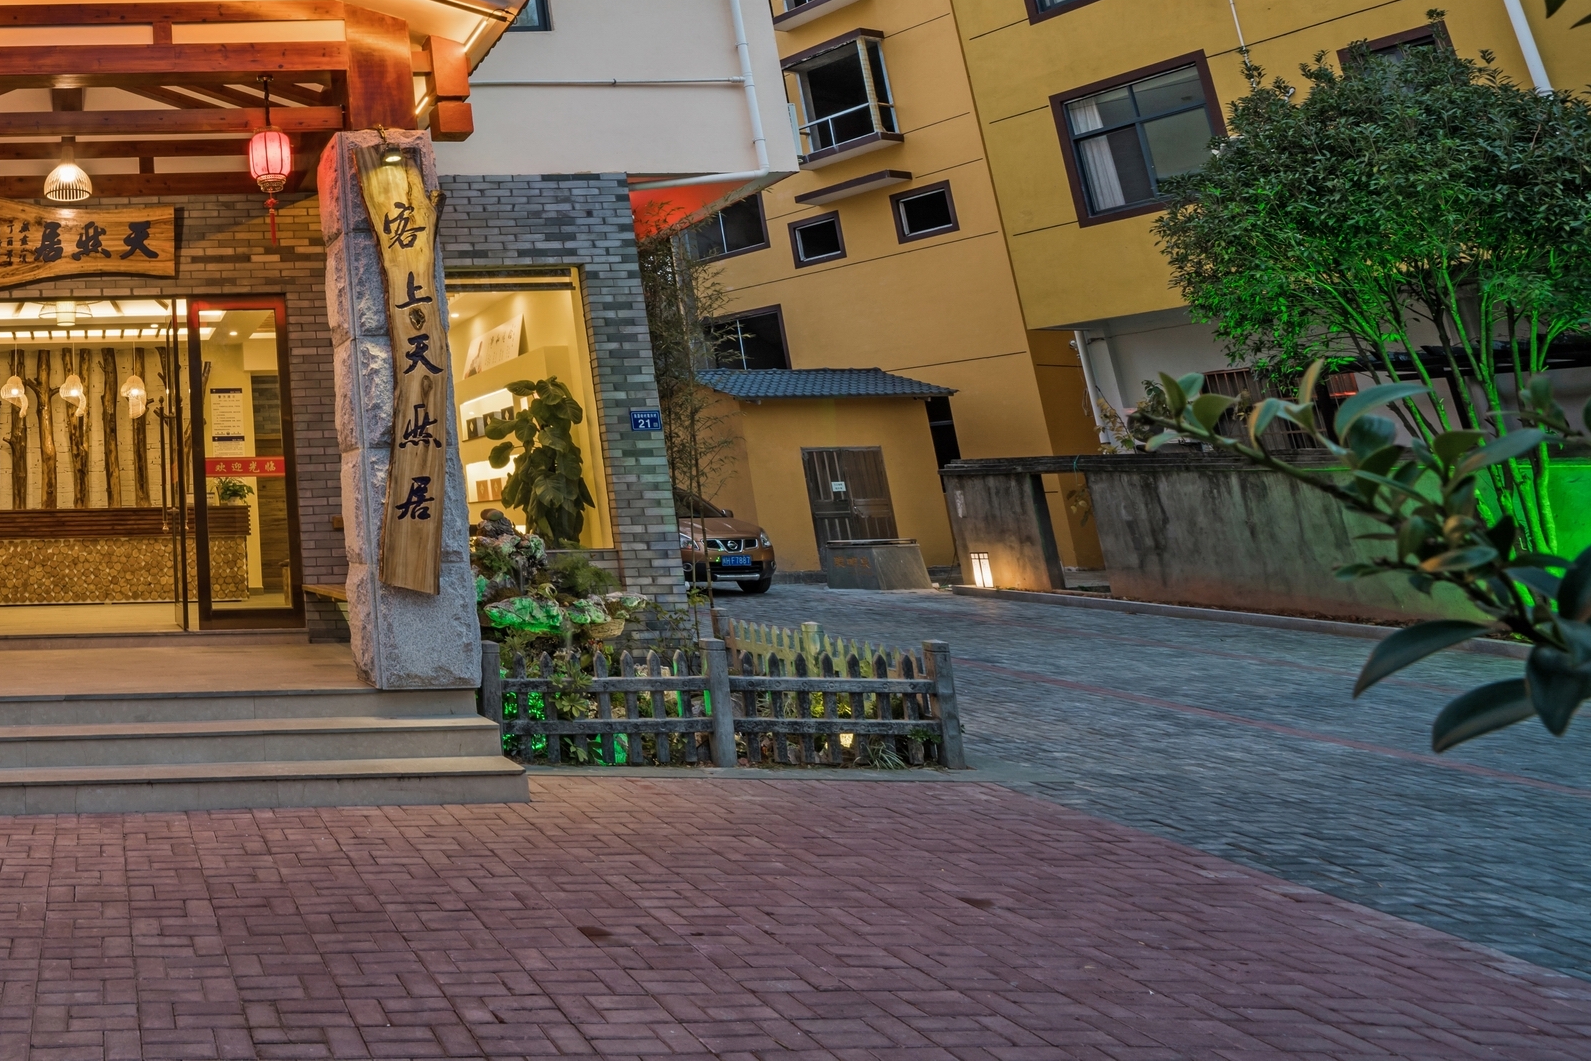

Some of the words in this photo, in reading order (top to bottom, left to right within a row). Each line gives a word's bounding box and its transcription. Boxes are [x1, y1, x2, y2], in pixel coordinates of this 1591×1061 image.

[637, 419, 651, 429] 21
[214, 460, 277, 473] 欢迎光临
